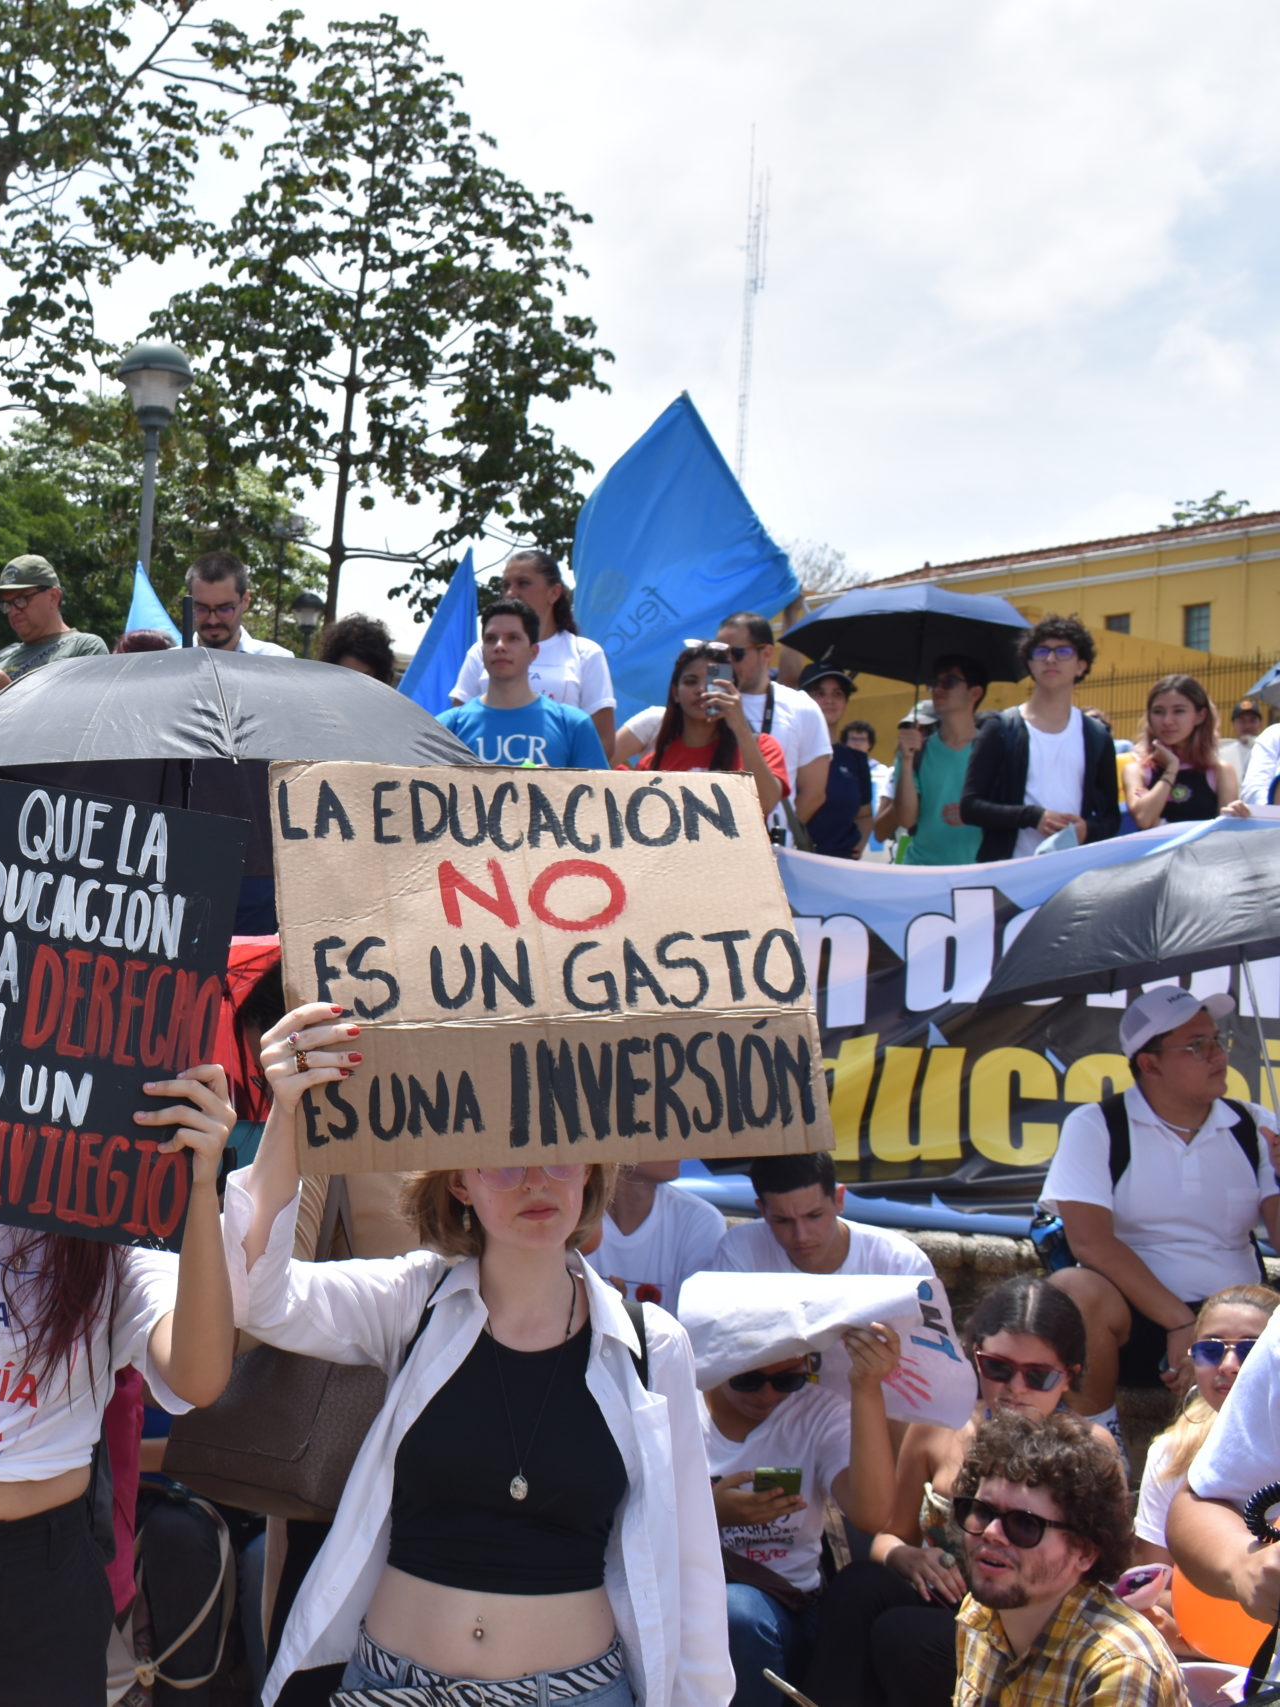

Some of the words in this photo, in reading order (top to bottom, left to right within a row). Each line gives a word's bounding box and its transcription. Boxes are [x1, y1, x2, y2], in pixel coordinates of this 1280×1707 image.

[476, 734, 550, 768] UCR
[19, 789, 112, 869] QUE
[117, 804, 167, 883] LA
[277, 778, 354, 841] LA
[373, 777, 740, 854] EDUCACIÓN
[437, 857, 626, 931] NO
[20, 944, 222, 1071] DERECHO
[314, 934, 401, 1019] ES
[430, 937, 535, 1011] UN
[562, 928, 808, 1012] GASTO
[20, 1064, 93, 1127] UN
[302, 1069, 359, 1148] ES
[369, 1069, 485, 1142] UNA
[509, 1018, 817, 1148] INVERSIÓN
